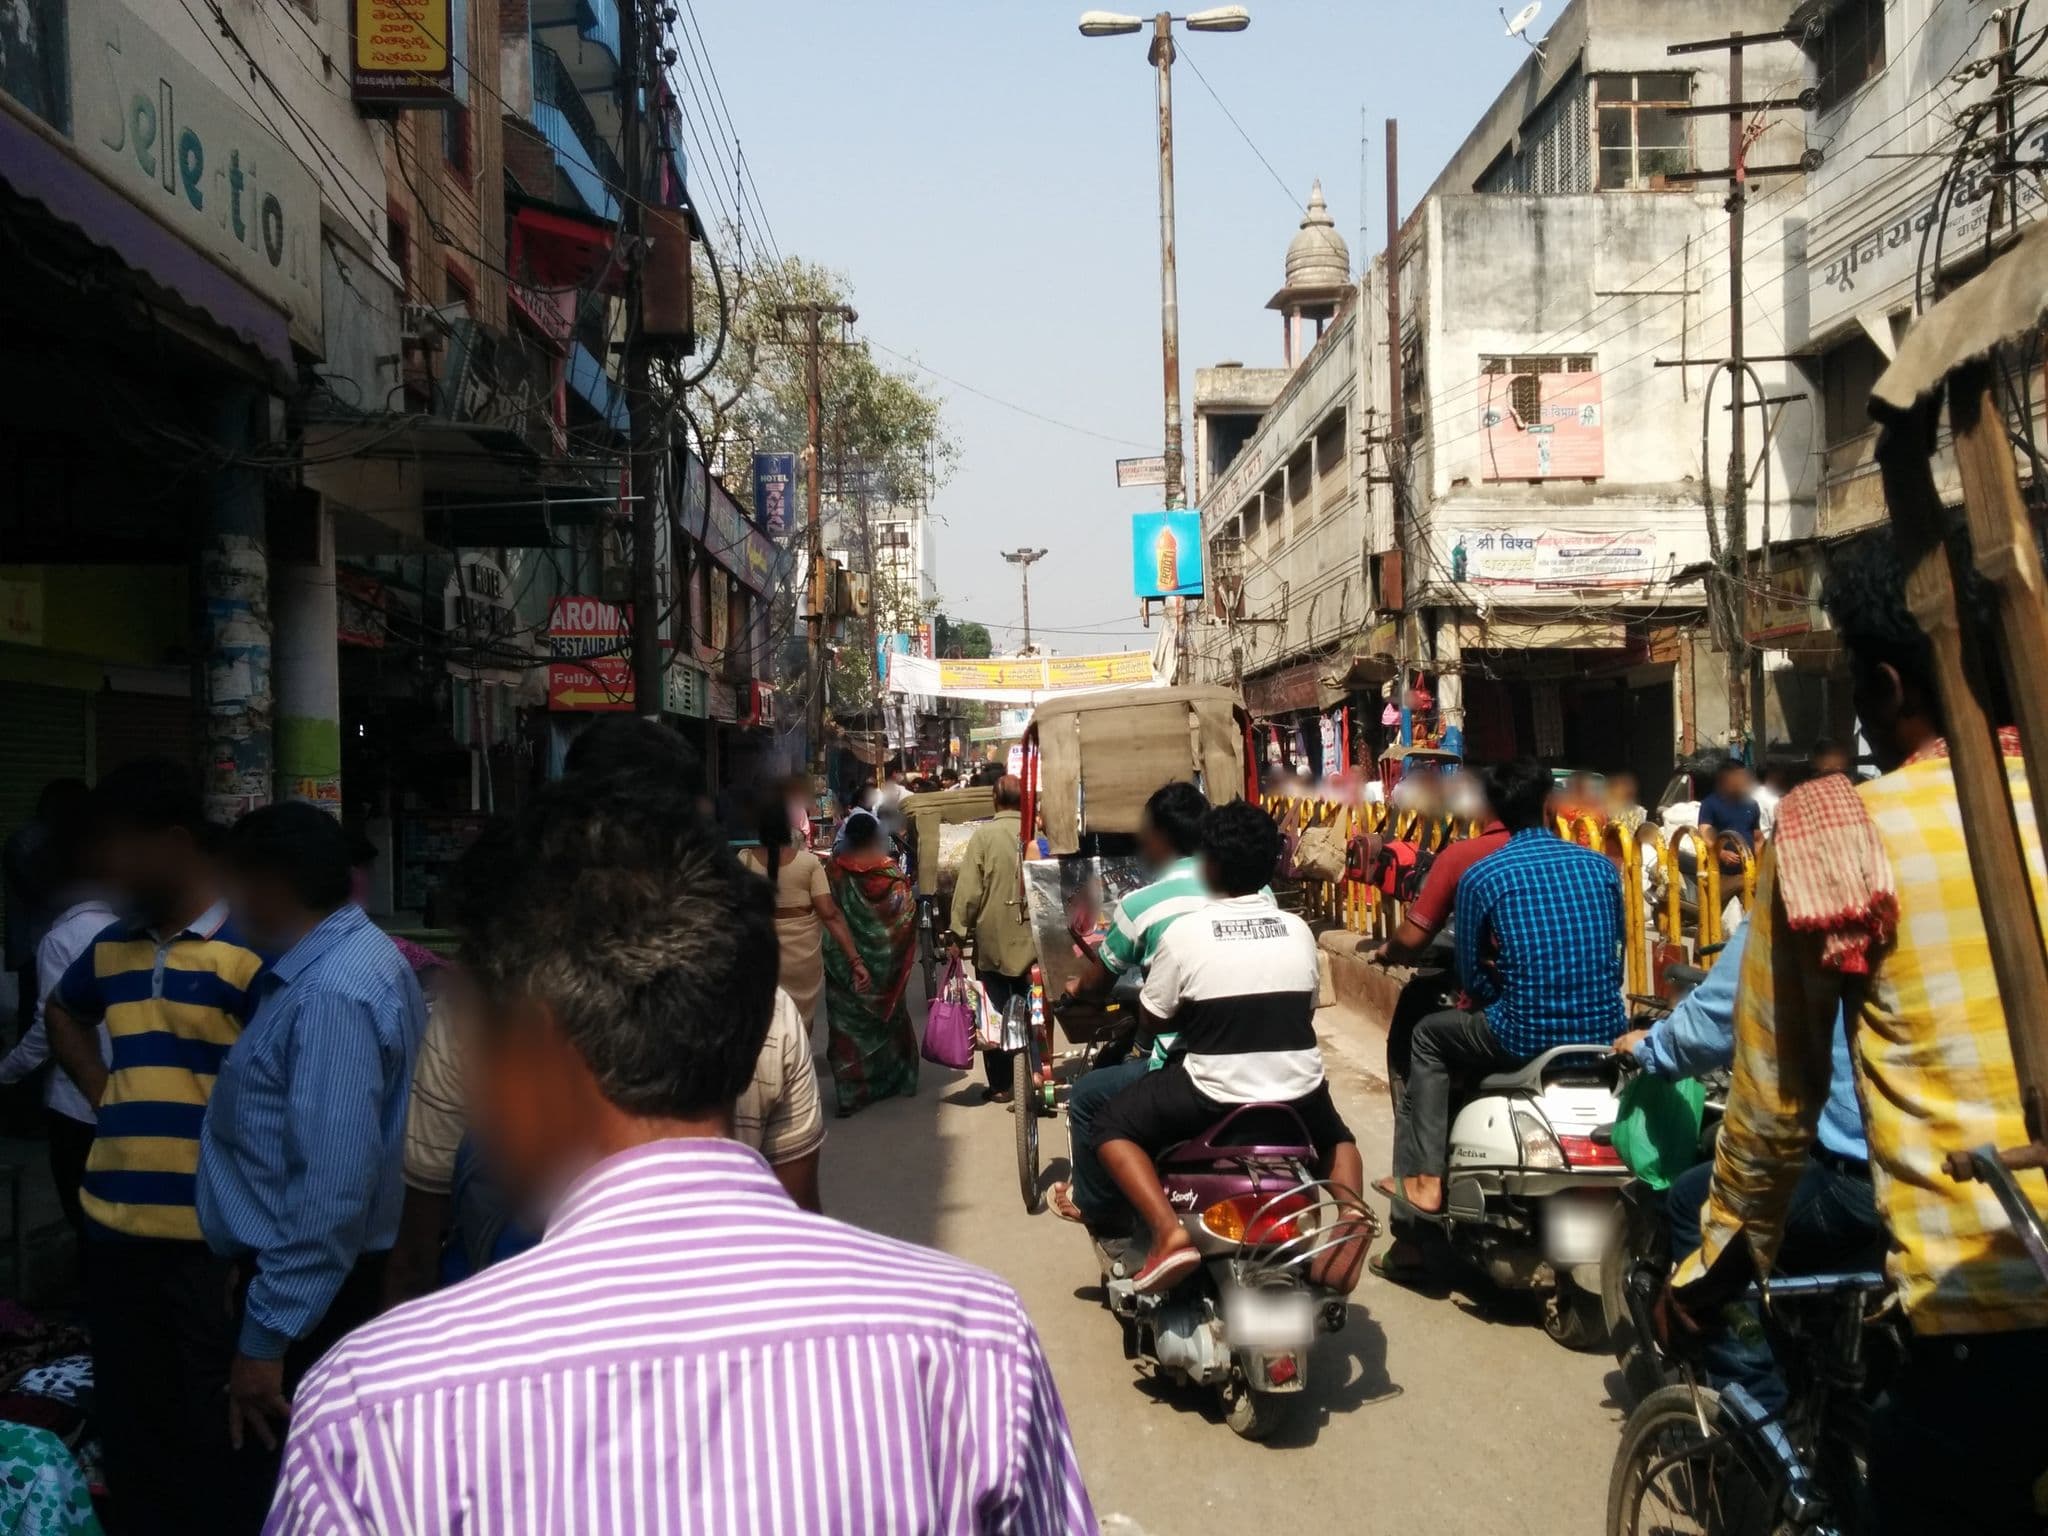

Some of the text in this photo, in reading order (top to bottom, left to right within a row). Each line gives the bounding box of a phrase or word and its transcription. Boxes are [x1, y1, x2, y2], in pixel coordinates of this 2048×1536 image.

[761, 474, 789, 483] HOTEL
[1476, 533, 1494, 550] श्री
[550, 601, 630, 631] AROMA
[554, 672, 593, 687] Fully
[1456, 1147, 1487, 1159] Activa
